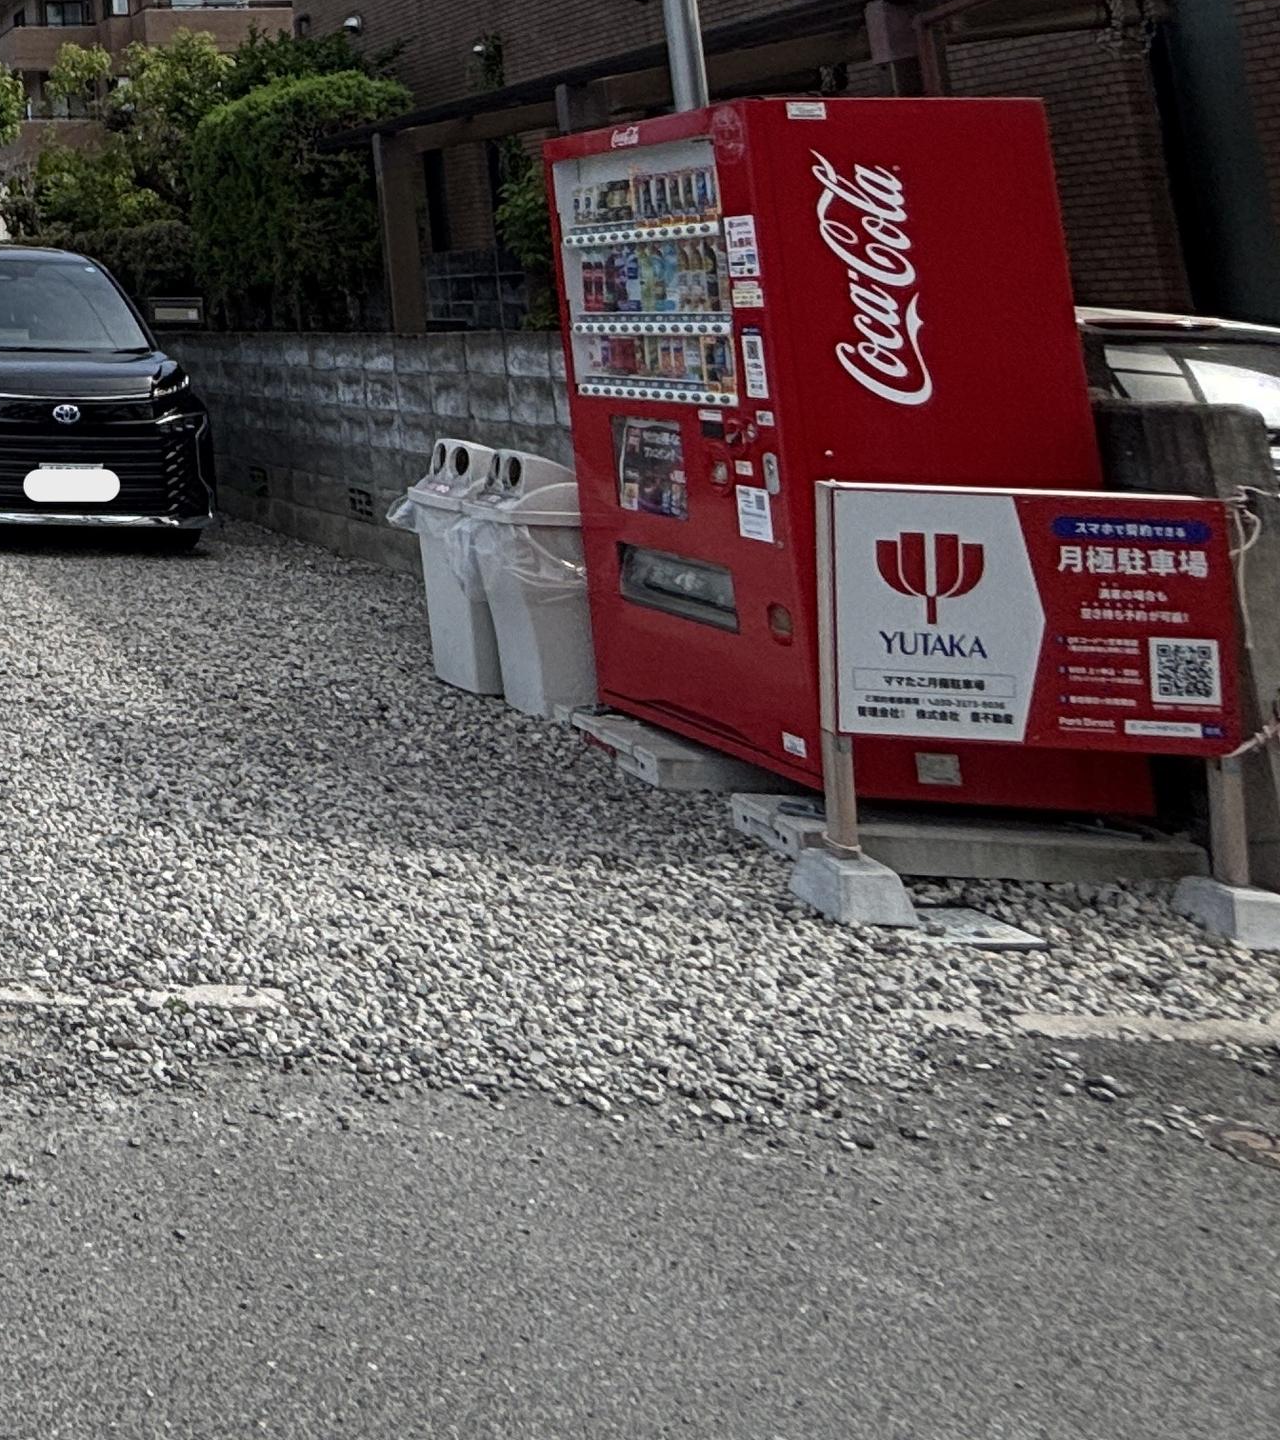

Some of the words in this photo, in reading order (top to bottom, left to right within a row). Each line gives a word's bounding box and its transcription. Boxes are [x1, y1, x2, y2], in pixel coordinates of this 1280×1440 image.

[810, 148, 933, 405] Coca-Cola
[1057, 545, 1209, 578] 月極駐車場
[879, 630, 988, 659] YUTAKA
